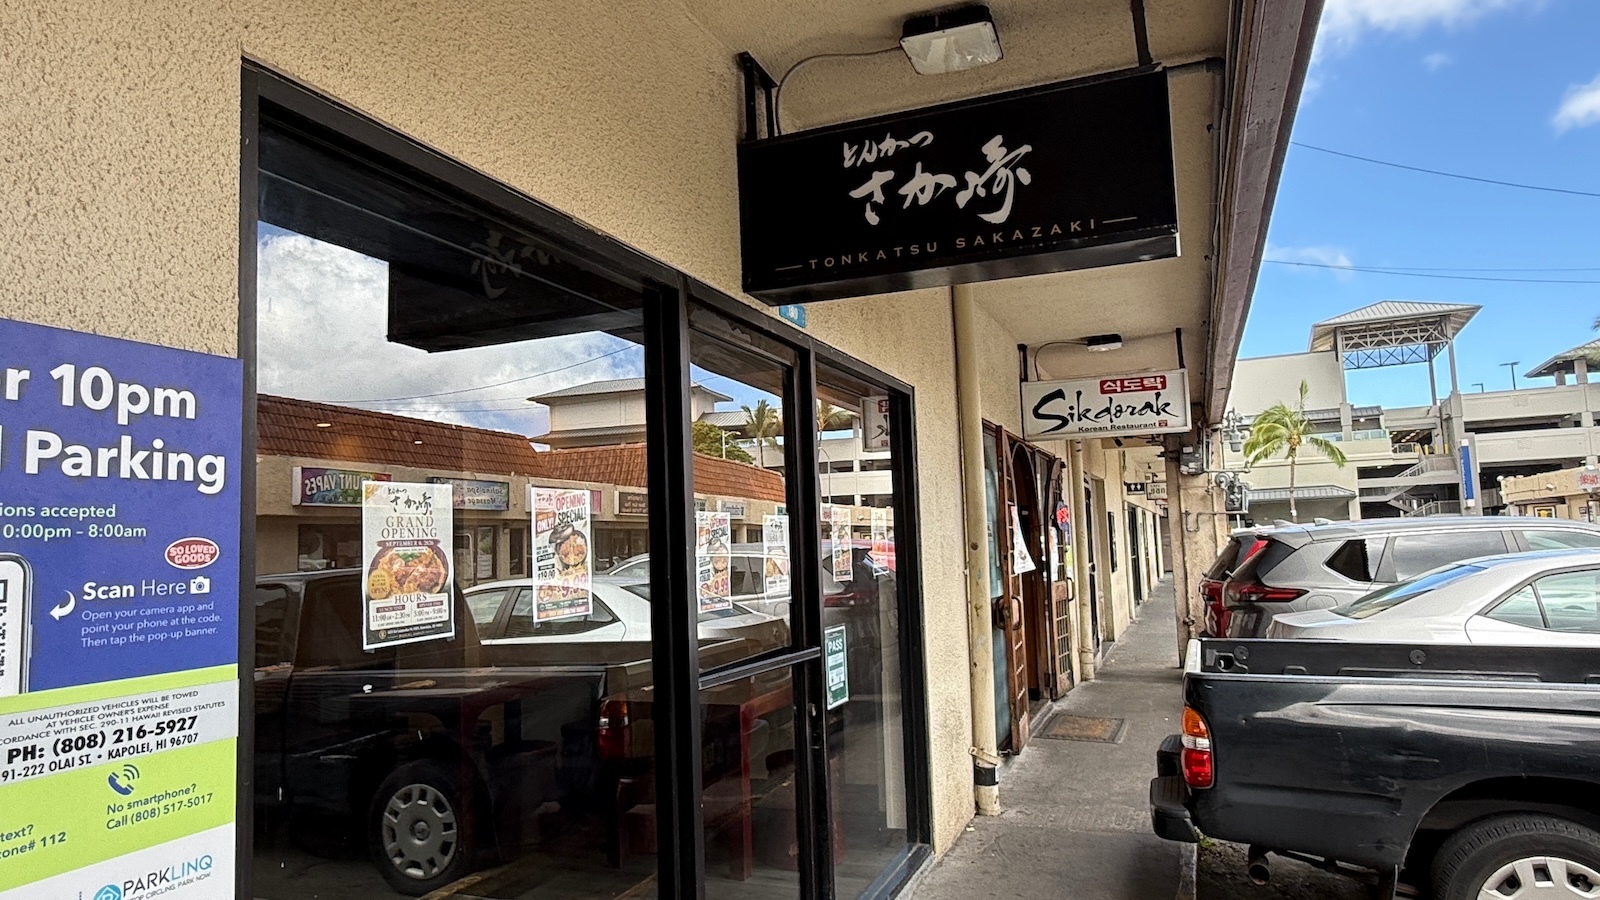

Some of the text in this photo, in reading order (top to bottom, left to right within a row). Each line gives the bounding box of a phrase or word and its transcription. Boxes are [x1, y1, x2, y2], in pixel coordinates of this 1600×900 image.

[843, 130, 935, 168] とんかつ
[809, 218, 1096, 270] TONKATSU SAKAZAKI
[50, 363, 196, 425] 10pm
[1103, 376, 1165, 393] 식도락
[1032, 388, 1180, 435] Sikdorak
[1078, 425, 1108, 433] Korean
[1110, 421, 1156, 430] Restaurant
[25, 430, 226, 495] Parking
[40, 504, 116, 521] accepted
[556, 493, 586, 511] OPENING
[385, 515, 434, 528] GRAND
[557, 506, 587, 525] SPECIAL!
[88, 524, 147, 538] 8:00am
[381, 527, 437, 539] OPENING
[169, 544, 216, 557] SO LOVED
[174, 554, 211, 565] GOODS
[82, 579, 187, 600] Scan Here
[394, 592, 428, 604] HOURS
[81, 601, 214, 622] Open your camera app and
[81, 614, 222, 636] point your phone at the code.
[81, 626, 218, 648] Then tap the pop-up banner.
[828, 638, 843, 654] PASS
[8, 690, 199, 727] ALL UNAUTHORIZED VEHICLES WILL BE TOWED
[45, 702, 169, 729] AT VEHICLE OWNER'S EXPENSE
[53, 726, 77, 736] WITH
[79, 722, 98, 732] SEC.
[100, 717, 129, 728] 290-11
[132, 712, 161, 722] HAWAII
[163, 706, 192, 717] REVISED
[194, 700, 226, 712] STATUTES
[7, 715, 198, 765] PH: (808) 216-5927
[1, 763, 45, 782] 91-222
[49, 757, 75, 772] OLAI
[108, 742, 153, 760] KAPOLEI,
[156, 738, 167, 750] HI
[170, 733, 199, 747] 96707
[107, 783, 197, 815] No smartphone?
[106, 793, 213, 830] Call (808) 517-5017
[40, 832, 66, 848] 112
[123, 854, 213, 897] PARKLINQ
[177, 878, 194, 889] PARK
[195, 872, 211, 883] NOW
